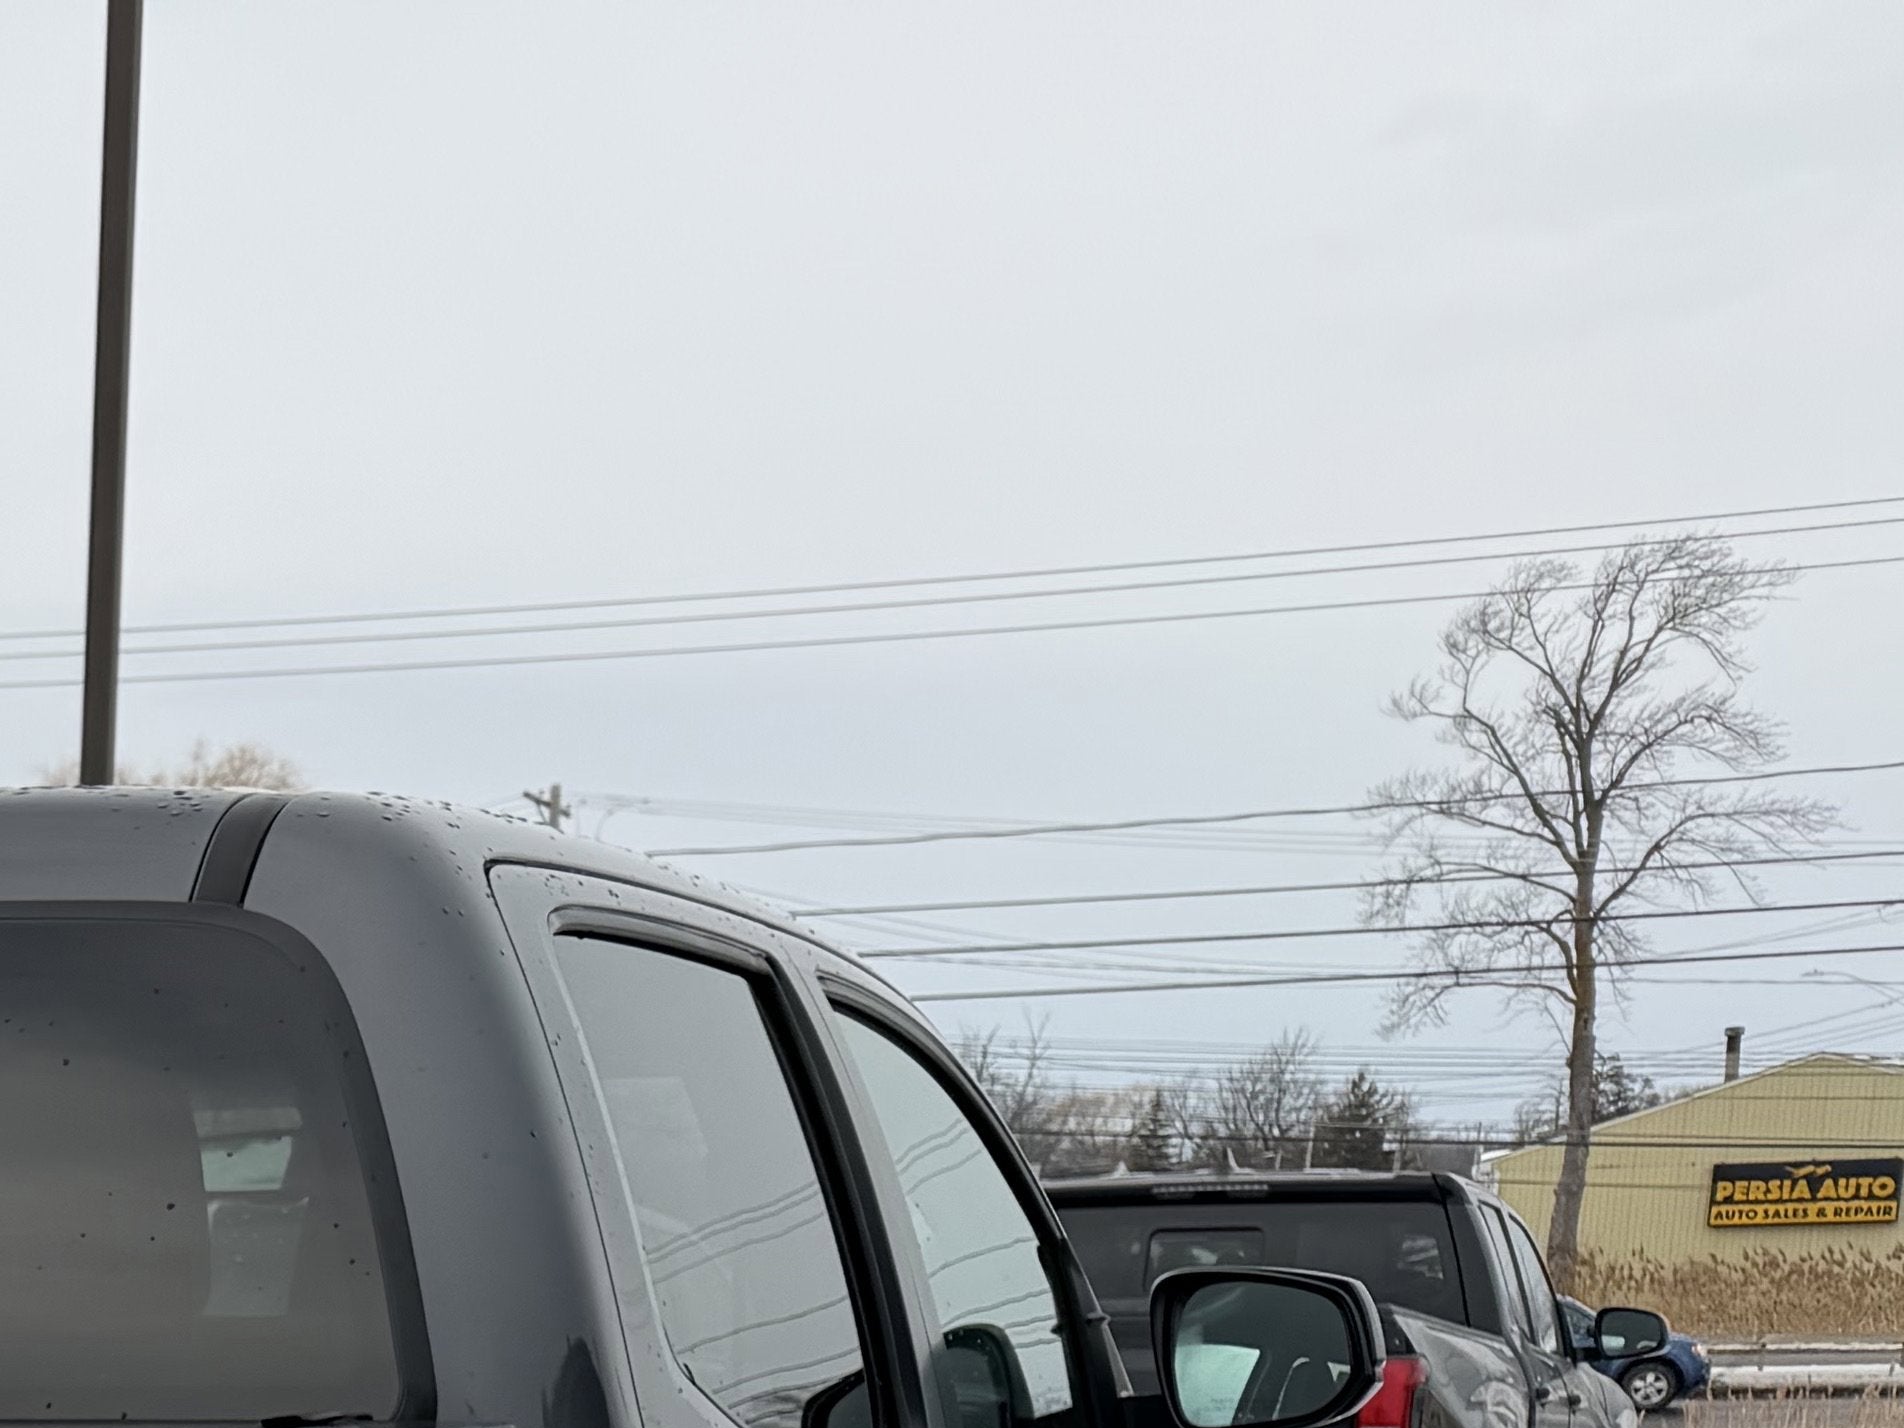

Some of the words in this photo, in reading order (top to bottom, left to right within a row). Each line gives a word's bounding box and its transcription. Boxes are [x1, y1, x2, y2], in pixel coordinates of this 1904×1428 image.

[1716, 1179, 1812, 1202] PERSIA
[1816, 1176, 1896, 1200] AUTO
[1714, 1208, 1758, 1222] AUTO
[1762, 1206, 1809, 1220] SALES
[1816, 1206, 1827, 1219] &
[1833, 1205, 1894, 1219] REPAIR
